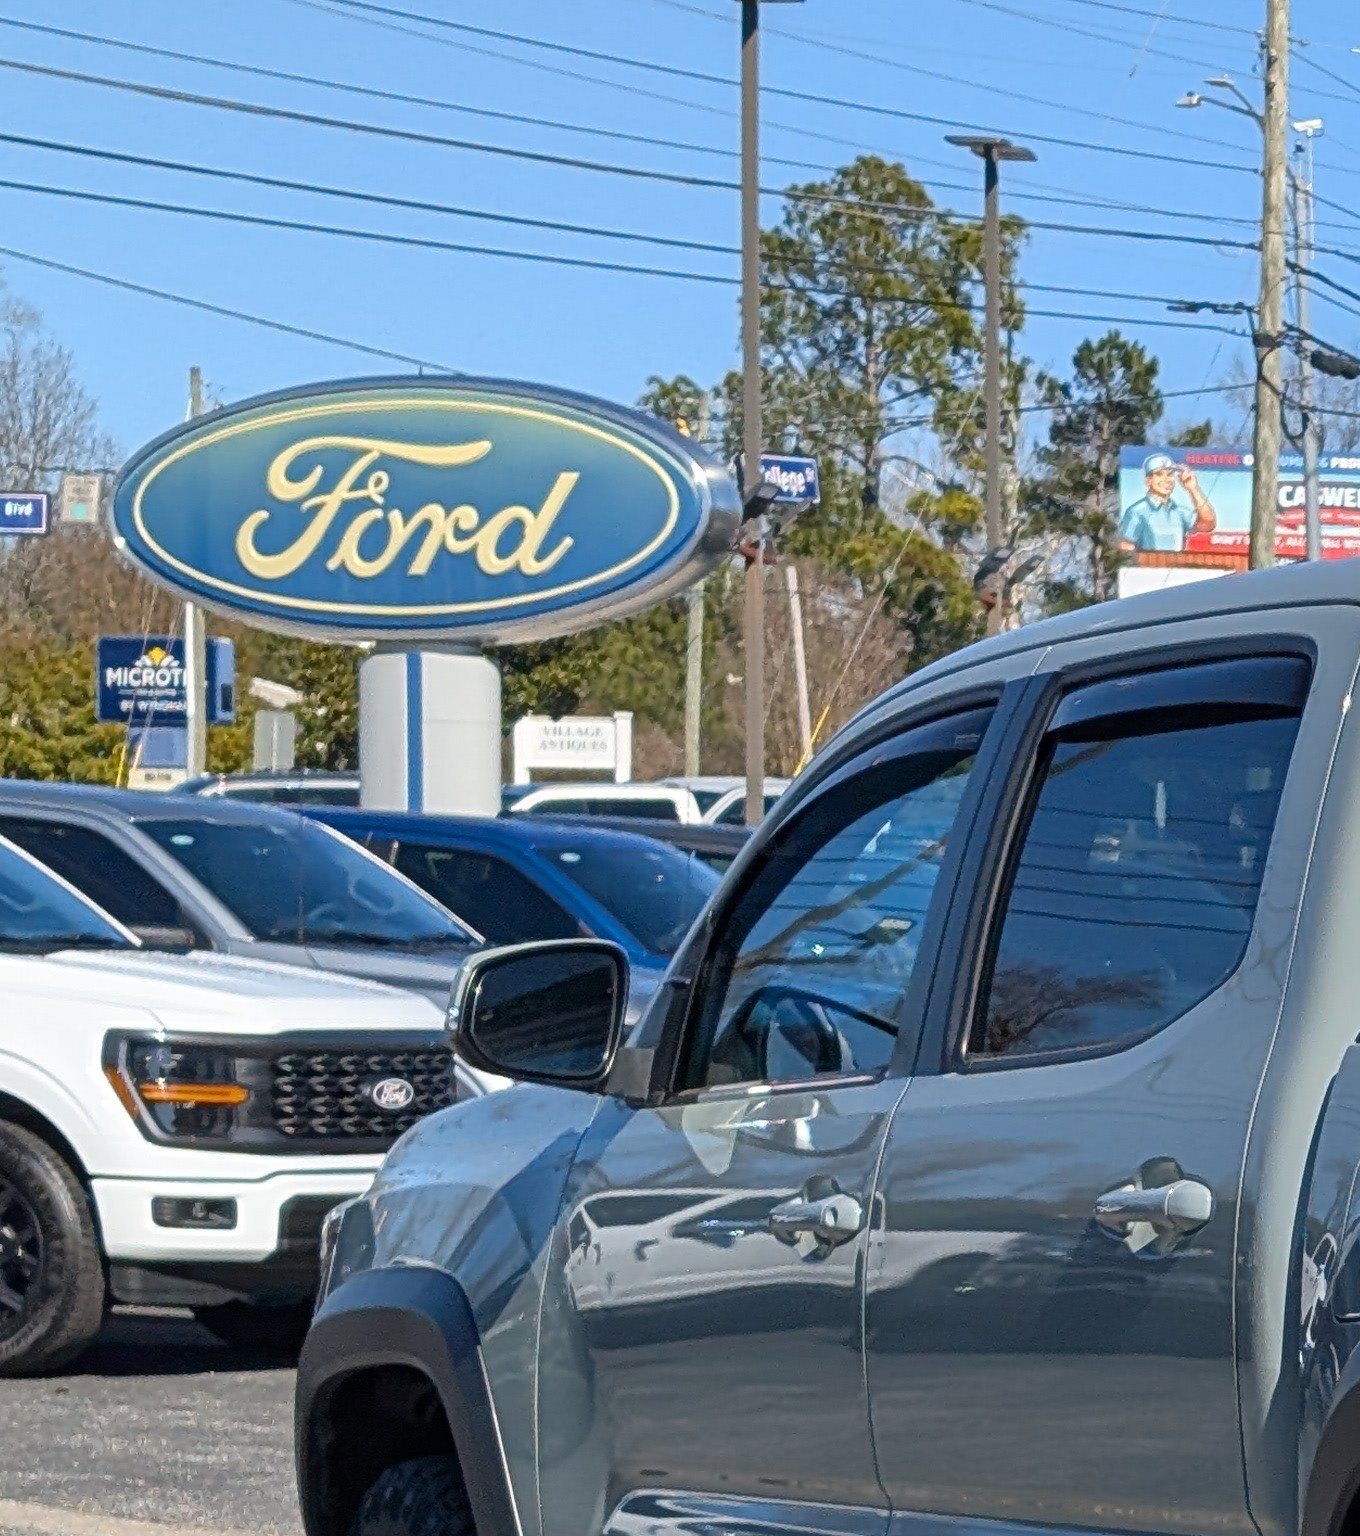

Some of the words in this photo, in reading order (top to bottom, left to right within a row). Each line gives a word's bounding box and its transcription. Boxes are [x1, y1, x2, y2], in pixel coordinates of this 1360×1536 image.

[4, 501, 33, 516] Blvd
[235, 435, 581, 579] Ford
[105, 667, 188, 689] MICROT
[542, 725, 604, 738] VILLAGE
